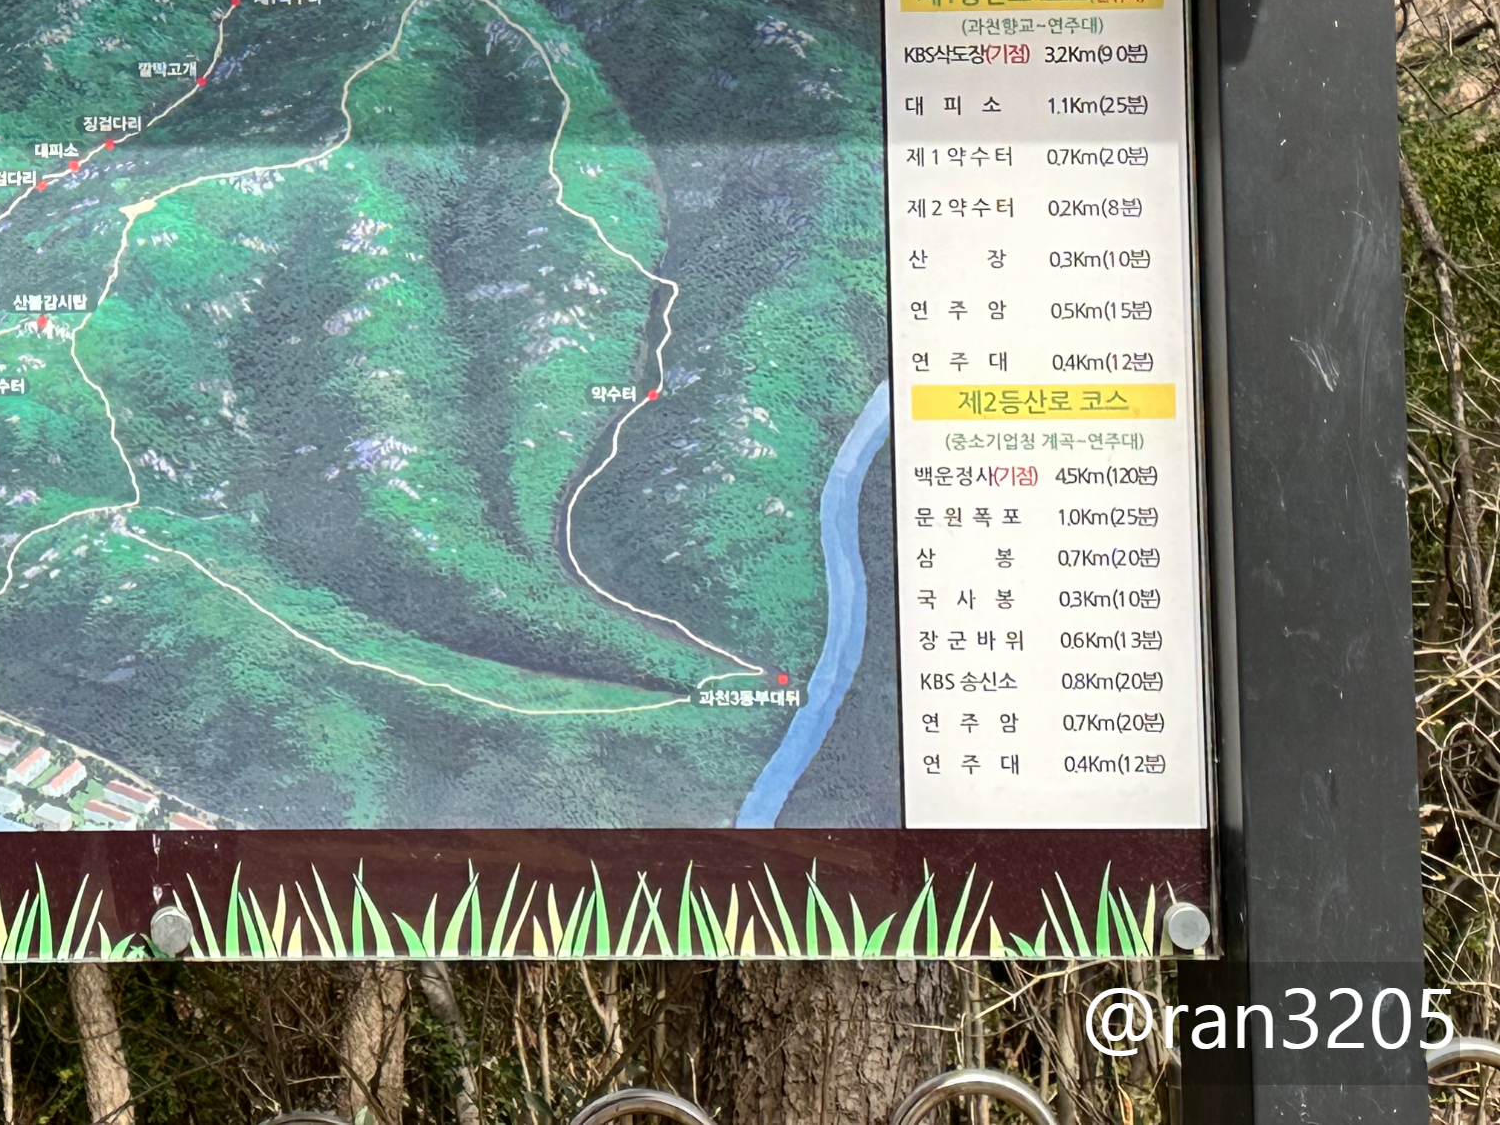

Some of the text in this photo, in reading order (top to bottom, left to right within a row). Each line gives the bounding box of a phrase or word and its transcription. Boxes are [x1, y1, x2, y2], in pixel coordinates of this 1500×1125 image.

[83, 116, 142, 132] 징검다리
[34, 143, 79, 158] 대피소
[13, 294, 87, 312] 산불감시탑
[591, 386, 637, 403] 약수터
[958, 389, 1130, 415] 제2등산로 코스
[920, 673, 955, 690] KBS
[960, 672, 1018, 692] 송신소
